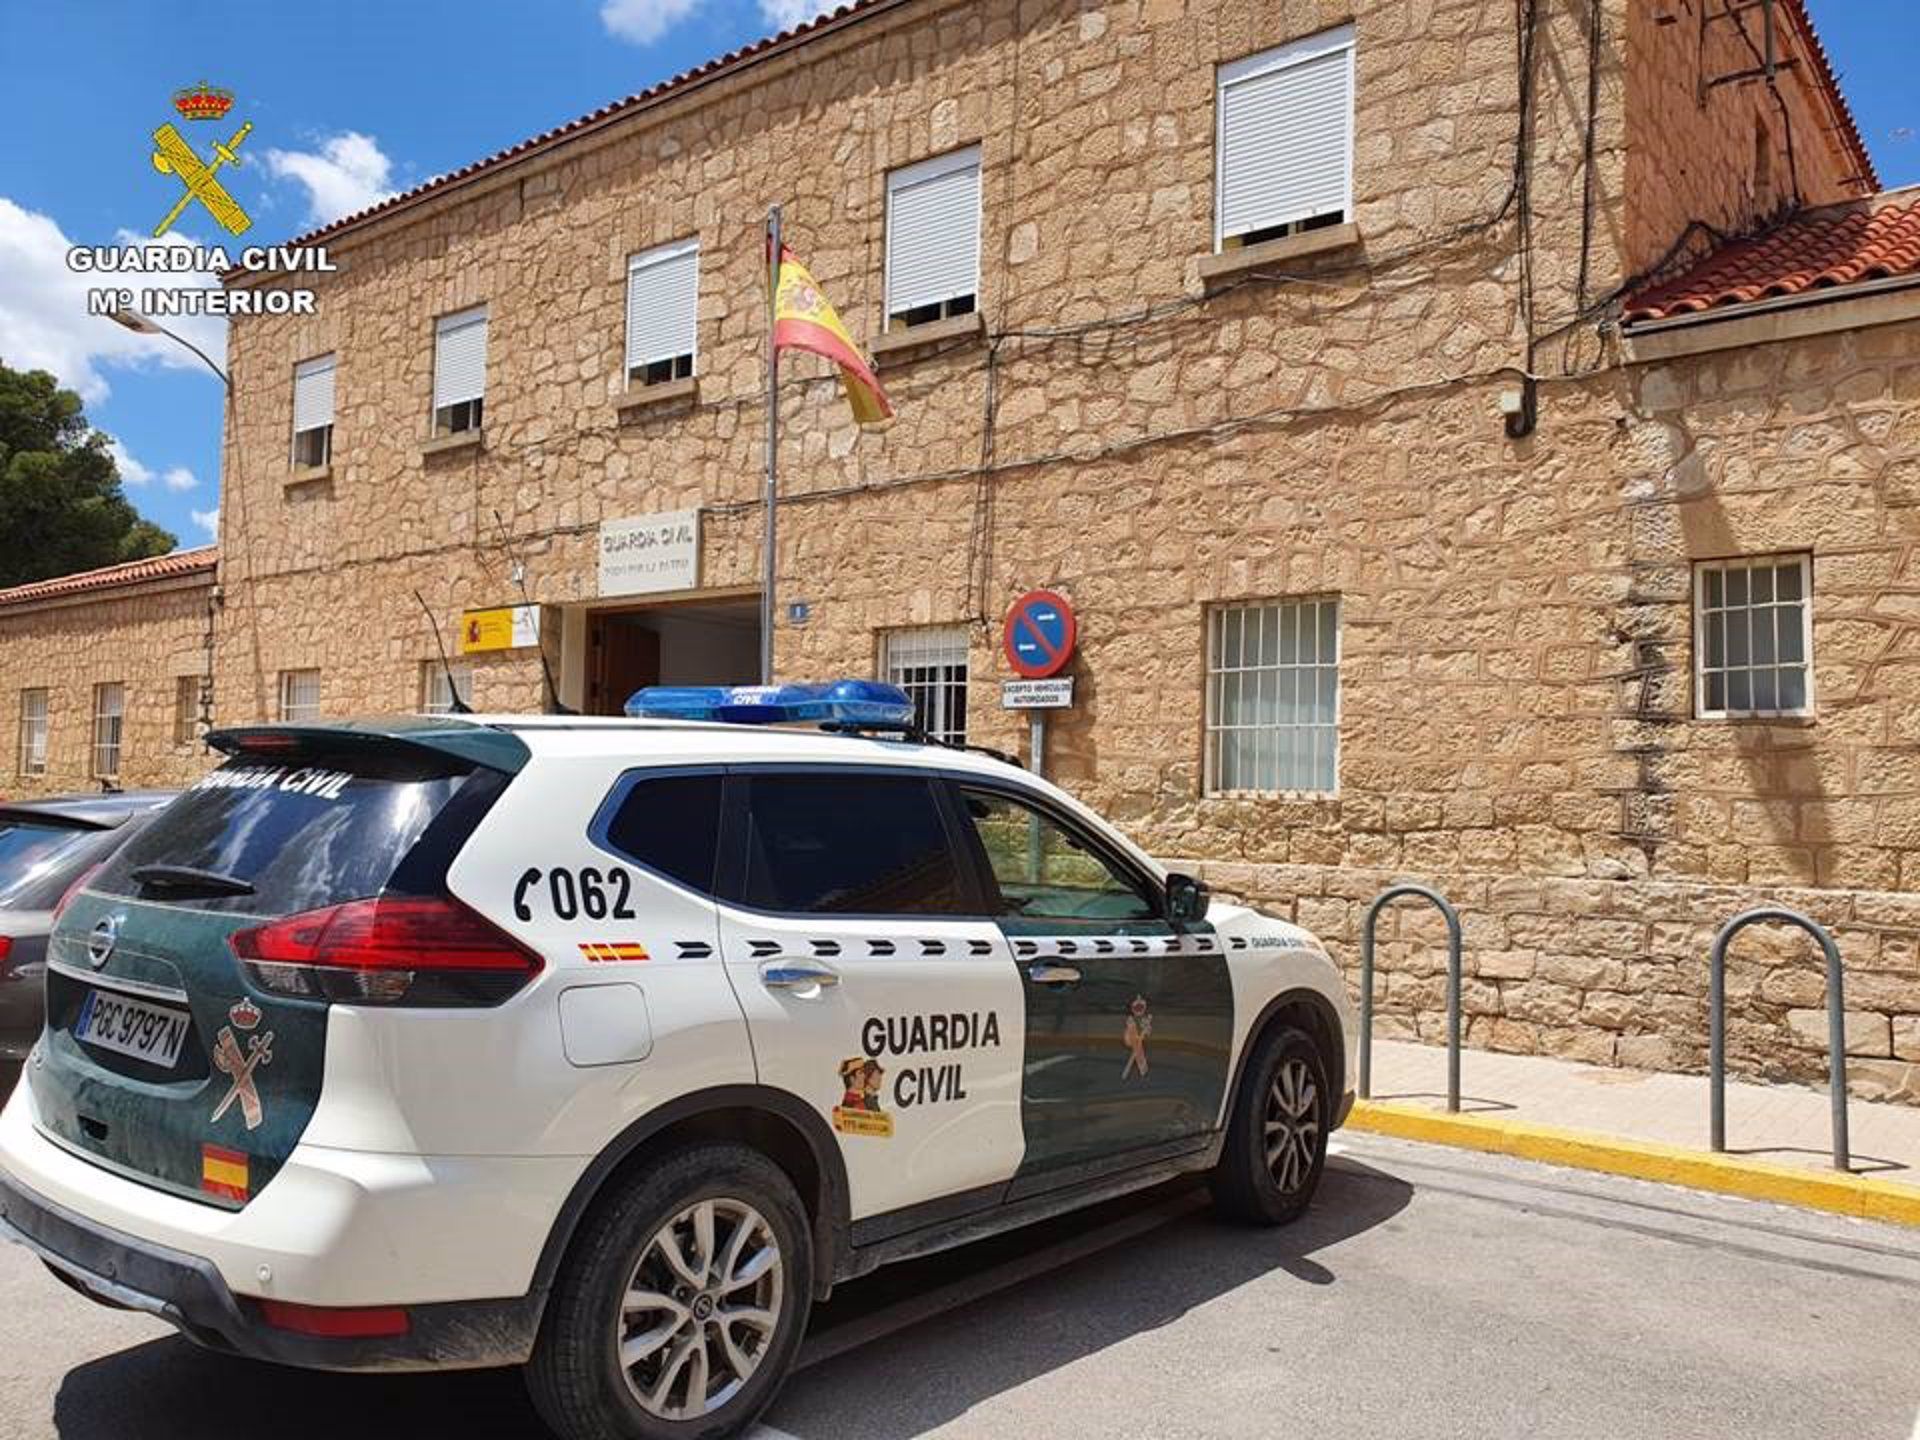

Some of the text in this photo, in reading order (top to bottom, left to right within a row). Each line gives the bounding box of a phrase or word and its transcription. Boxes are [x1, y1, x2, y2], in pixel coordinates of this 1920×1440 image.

[280, 767, 352, 799] CIVIL
[549, 867, 636, 920] 062
[1251, 937, 1288, 948] GUARDIA
[861, 1011, 1000, 1057] GUARDIA
[893, 1063, 967, 1109] CIVIL
